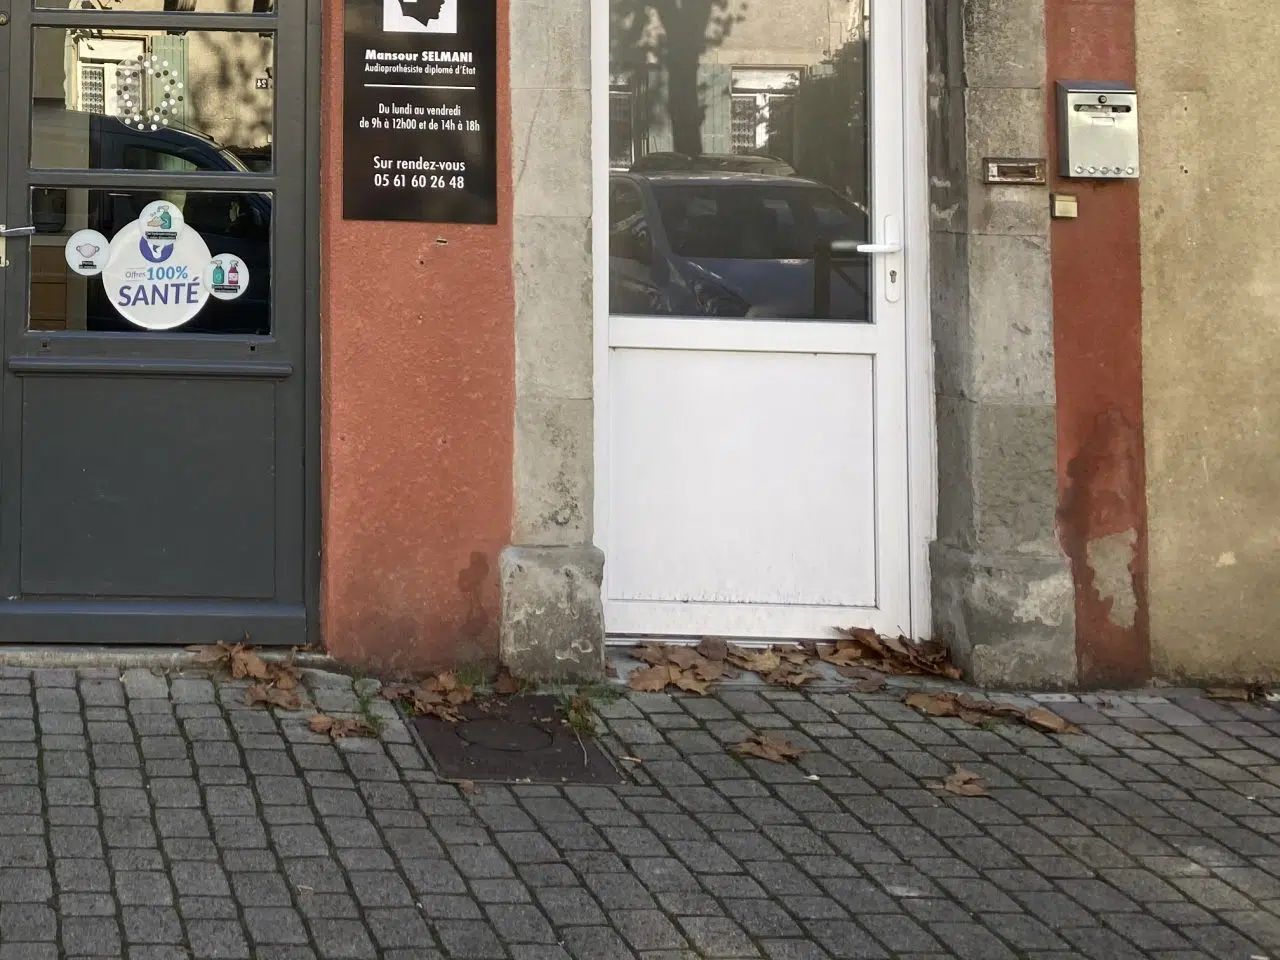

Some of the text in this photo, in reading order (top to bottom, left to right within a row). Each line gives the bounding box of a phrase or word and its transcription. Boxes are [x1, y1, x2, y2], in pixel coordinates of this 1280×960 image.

[365, 49, 473, 63] Mansour SELMANI
[365, 63, 423, 75] Audioprothésiste
[379, 103, 461, 116] Du lundi au vendredi
[360, 117, 480, 132] de 9h à 12h00 et de 14h à 18h
[373, 155, 465, 171] Sur rendez-vous
[374, 174, 464, 189] 05 61 60 26 48
[147, 266, 188, 280] 100%
[118, 276, 200, 307] SANTÉ
